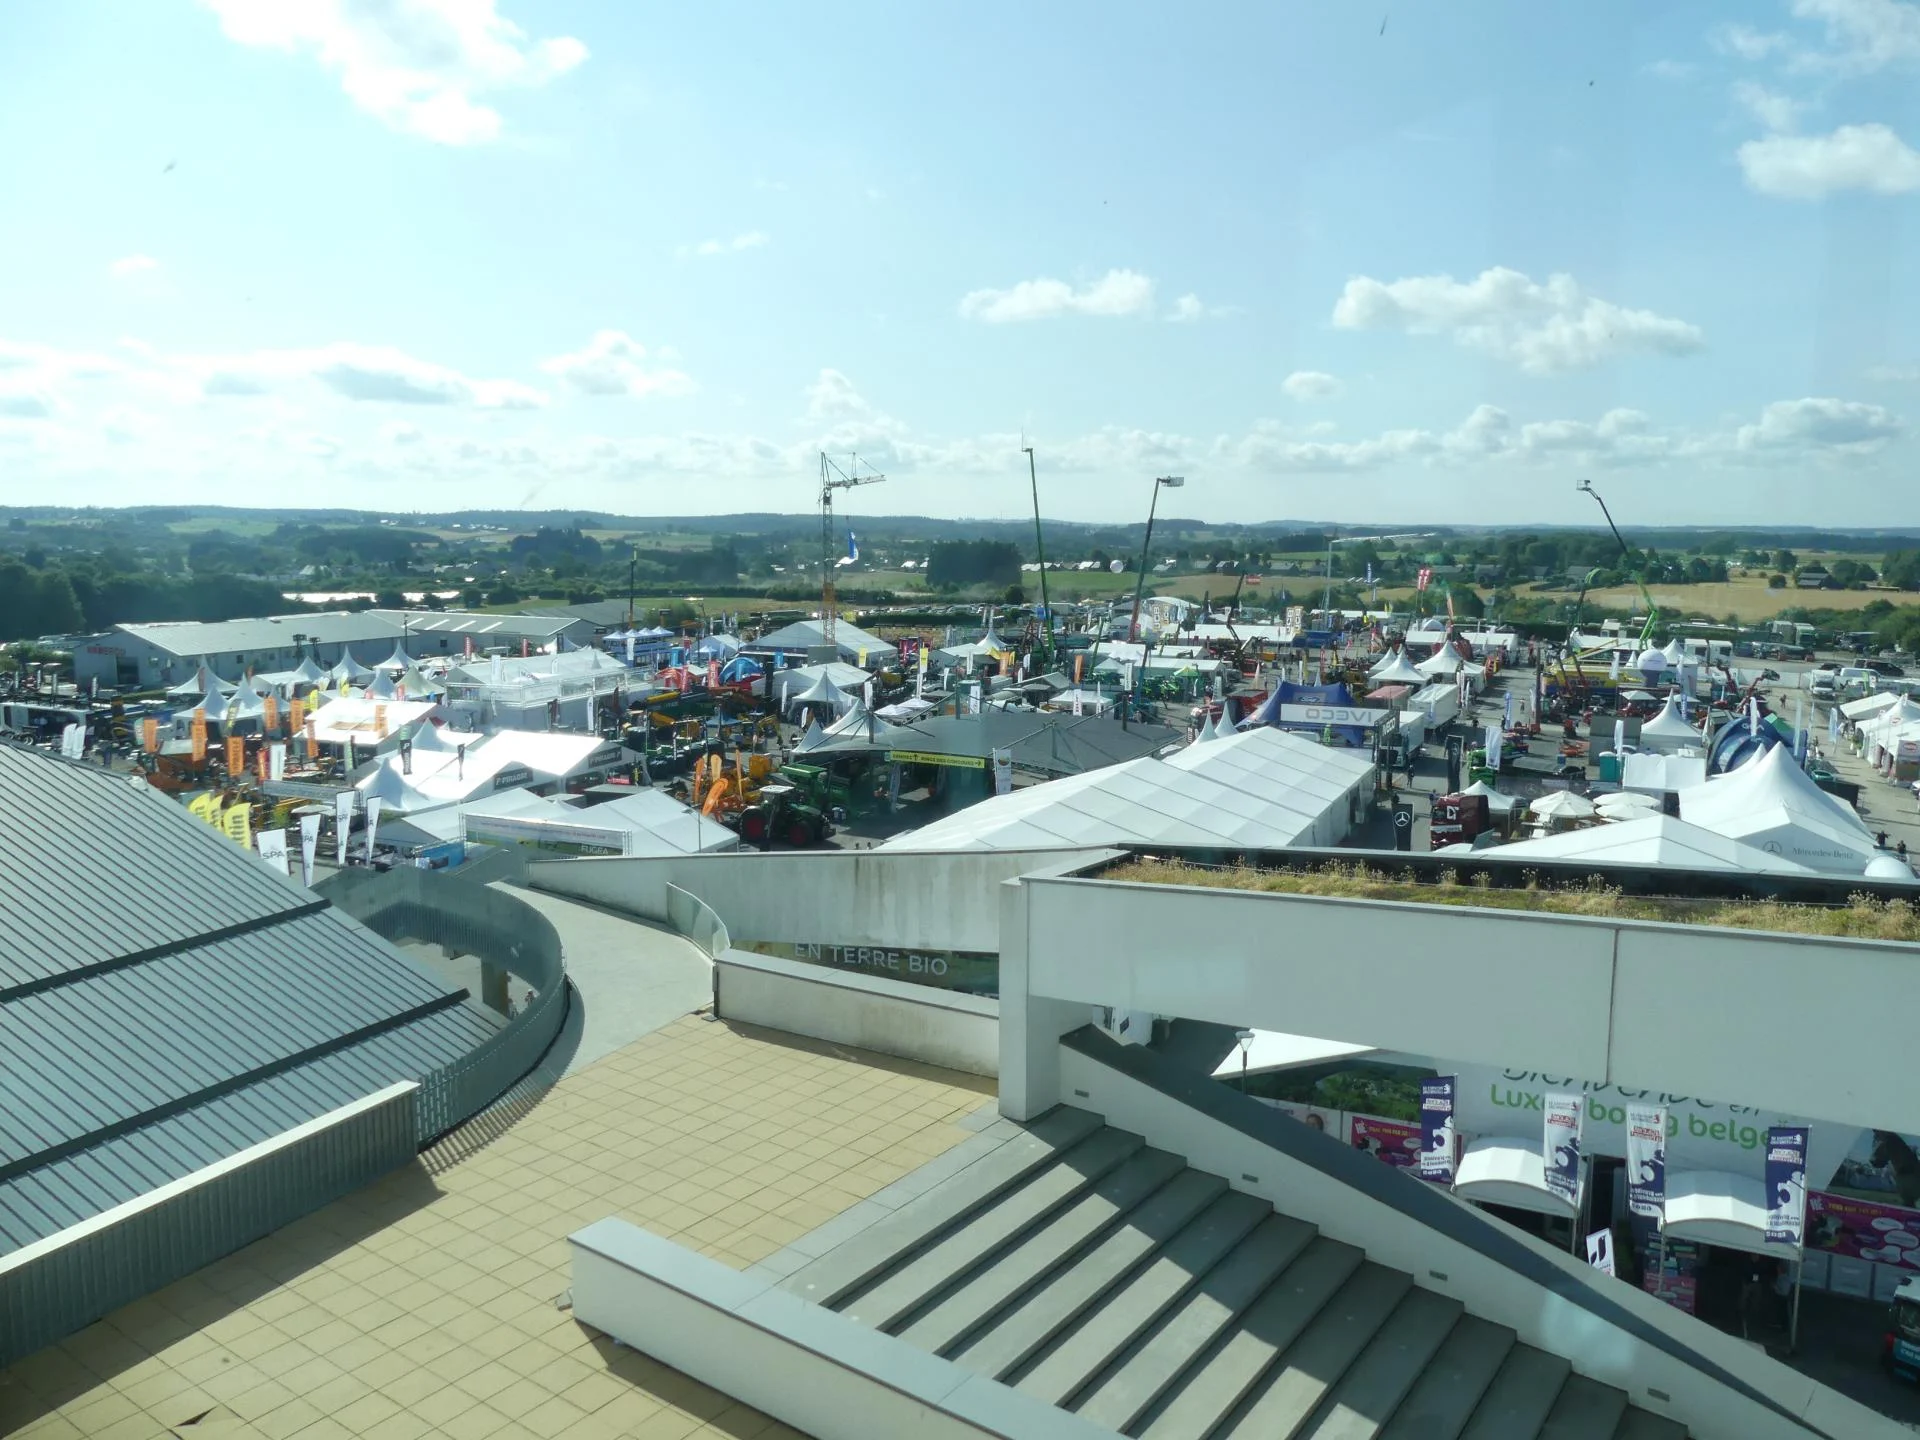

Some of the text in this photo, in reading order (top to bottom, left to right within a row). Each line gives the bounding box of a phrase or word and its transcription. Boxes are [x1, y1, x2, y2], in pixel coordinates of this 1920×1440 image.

[794, 943, 947, 976] EN TERRE BIO
